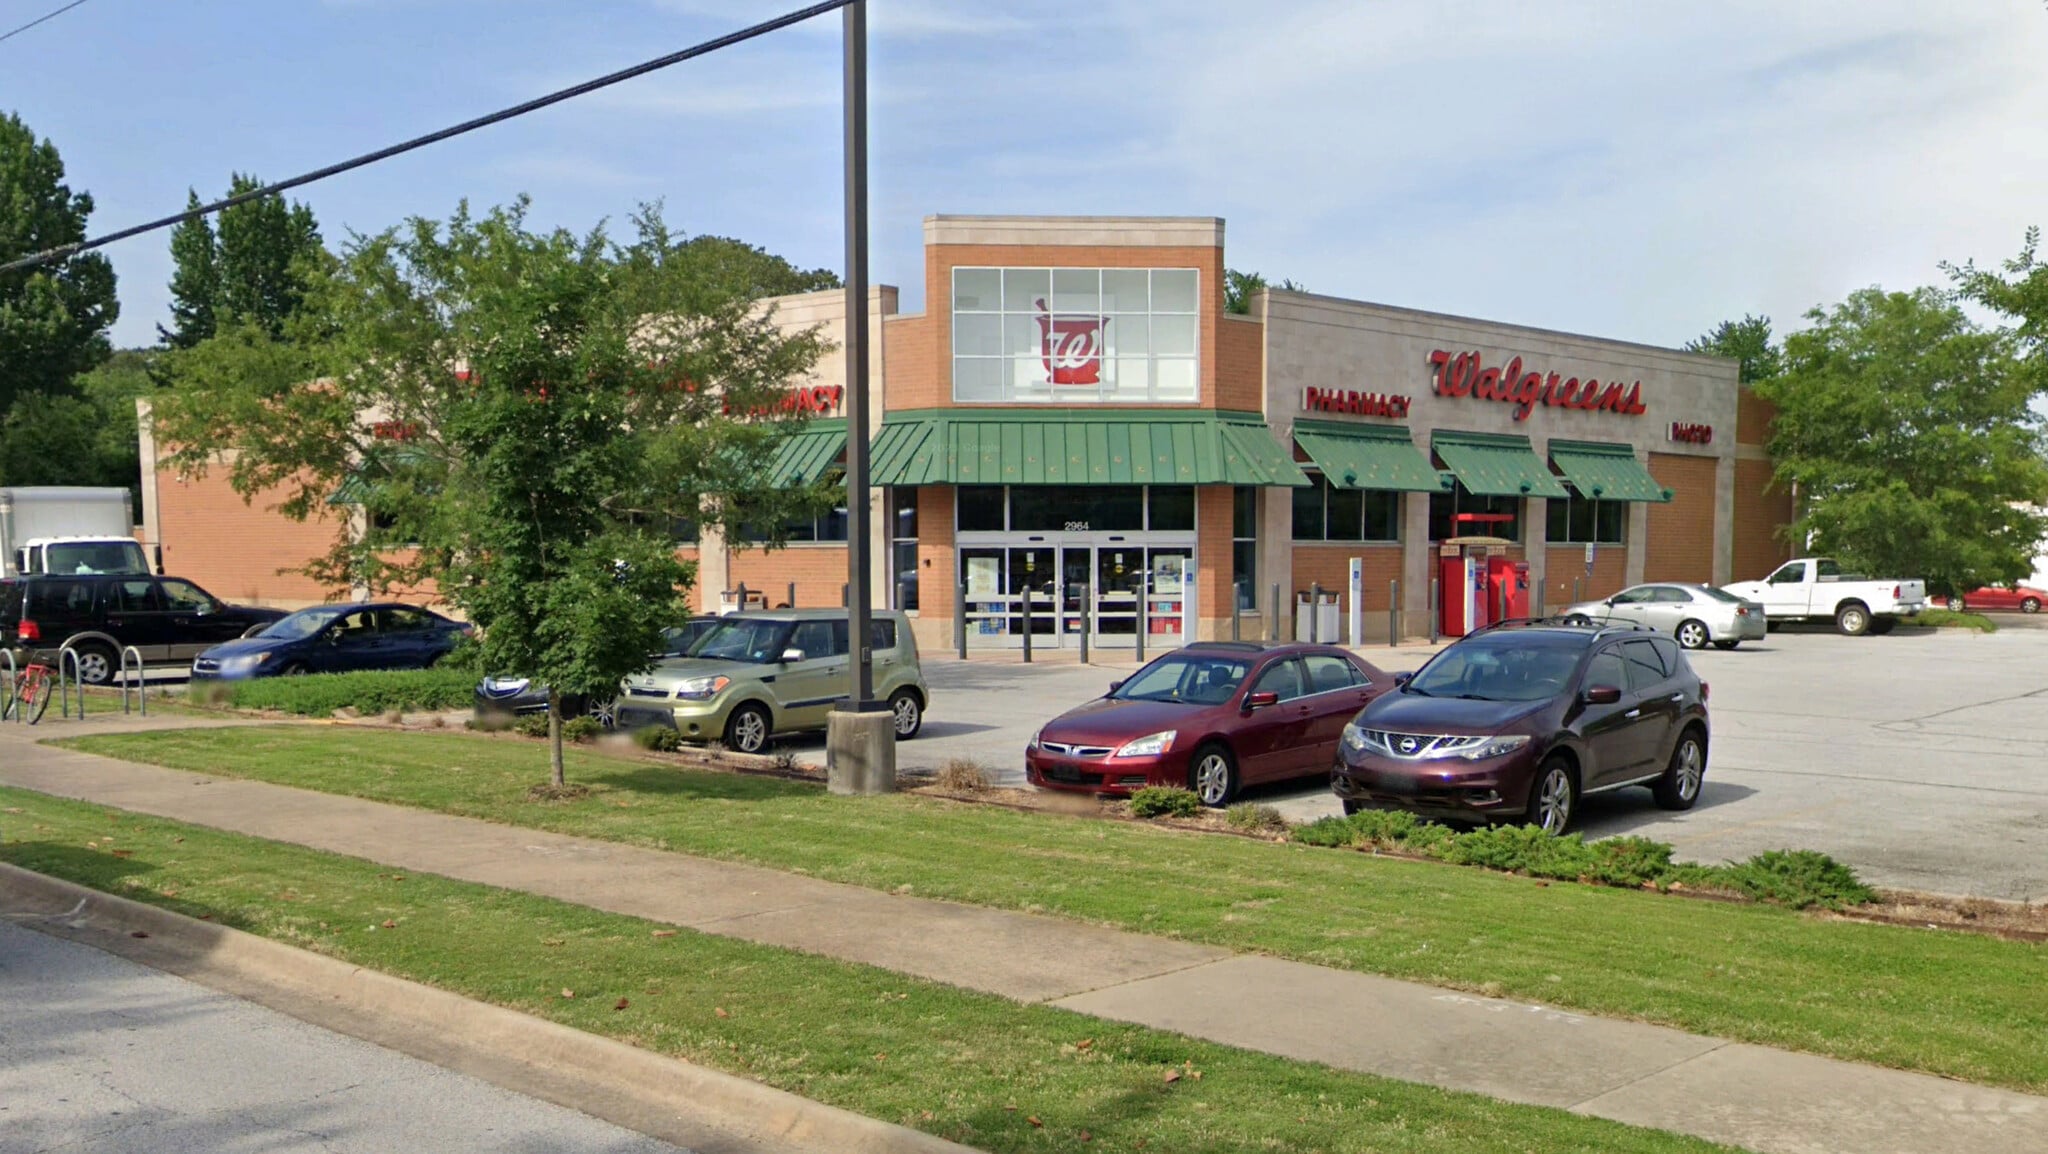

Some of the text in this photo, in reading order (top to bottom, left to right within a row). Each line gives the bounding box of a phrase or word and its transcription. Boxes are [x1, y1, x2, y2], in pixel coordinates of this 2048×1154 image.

[1426, 349, 1647, 421] Walgreens
[1303, 386, 1412, 418] PHARMACY
[1669, 422, 1713, 445] PHOTO
[1064, 521, 1089, 532] 2964
